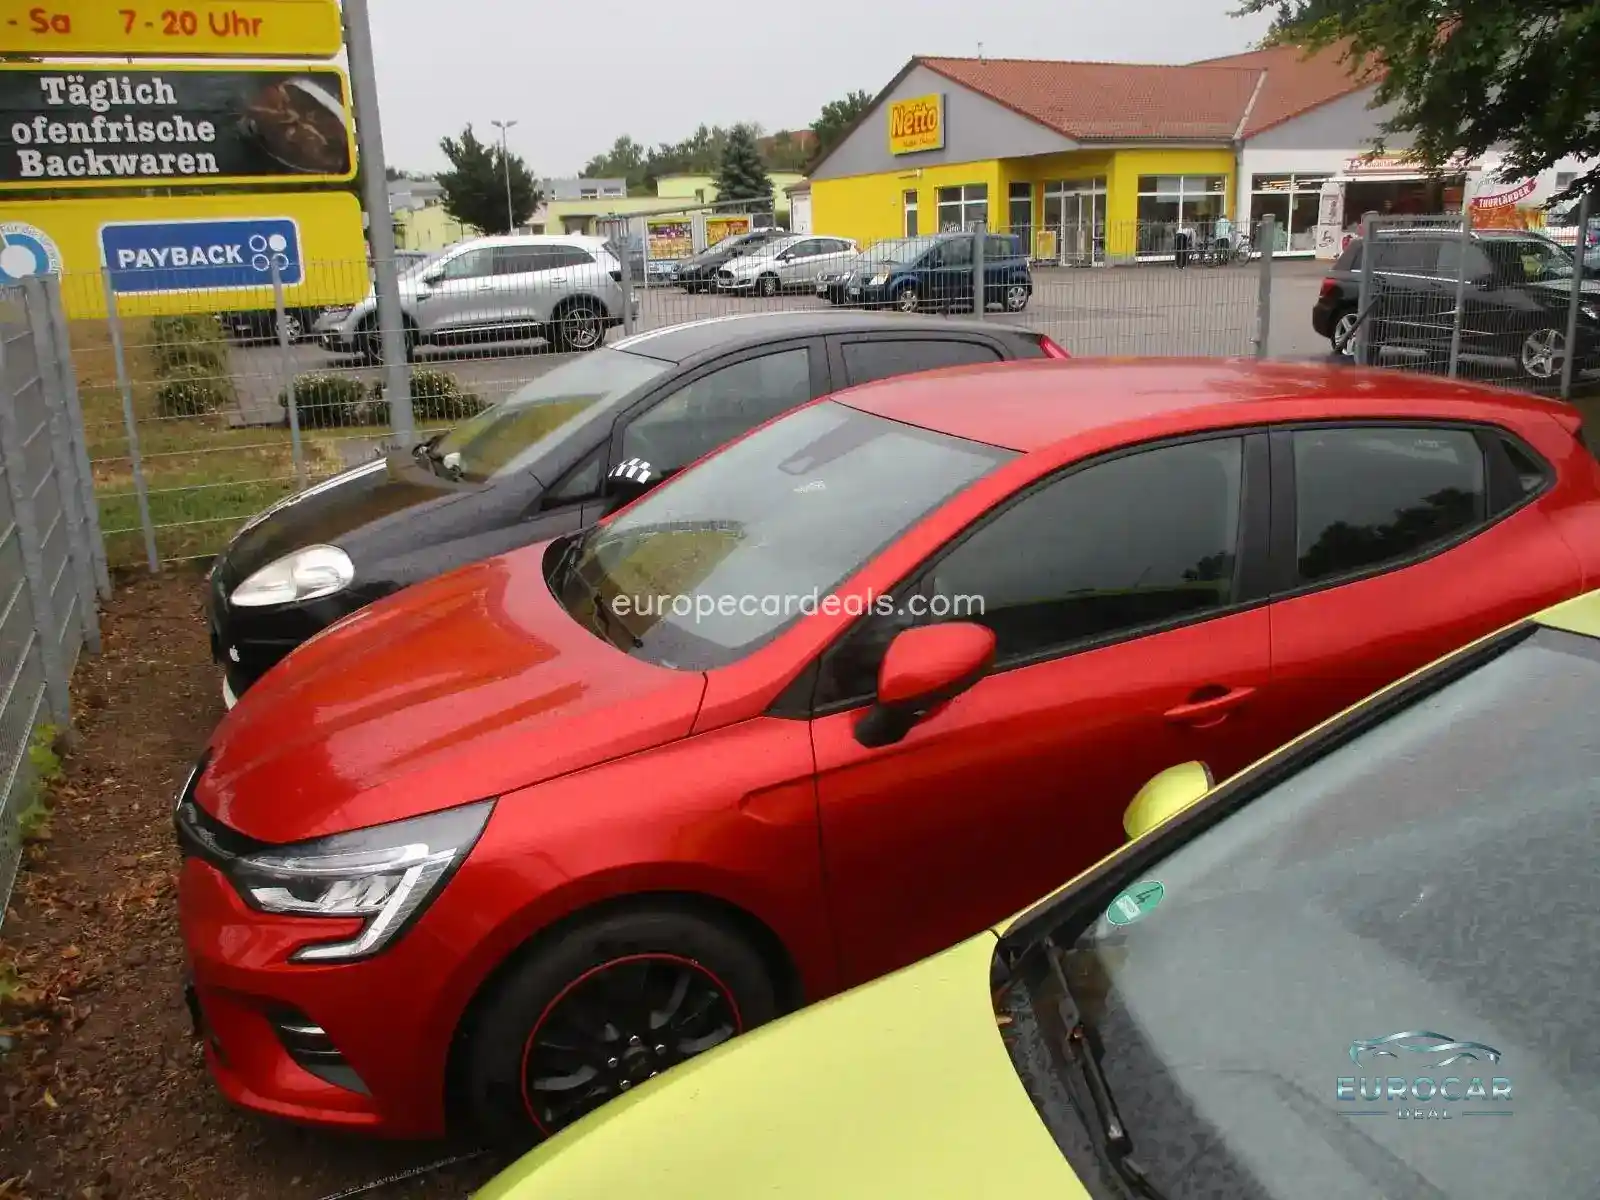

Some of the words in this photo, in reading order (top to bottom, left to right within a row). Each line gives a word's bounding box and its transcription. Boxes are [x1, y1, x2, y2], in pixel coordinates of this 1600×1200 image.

[29, 8, 71, 34] Sa
[118, 9, 137, 35] 7
[161, 9, 198, 36] 20
[208, 10, 263, 37] Uhr
[40, 74, 178, 112] Täglich
[11, 114, 216, 144] ofenfrische
[892, 103, 937, 137] Netto
[16, 148, 220, 177] Backwaren
[117, 244, 244, 268] PAYBACK
